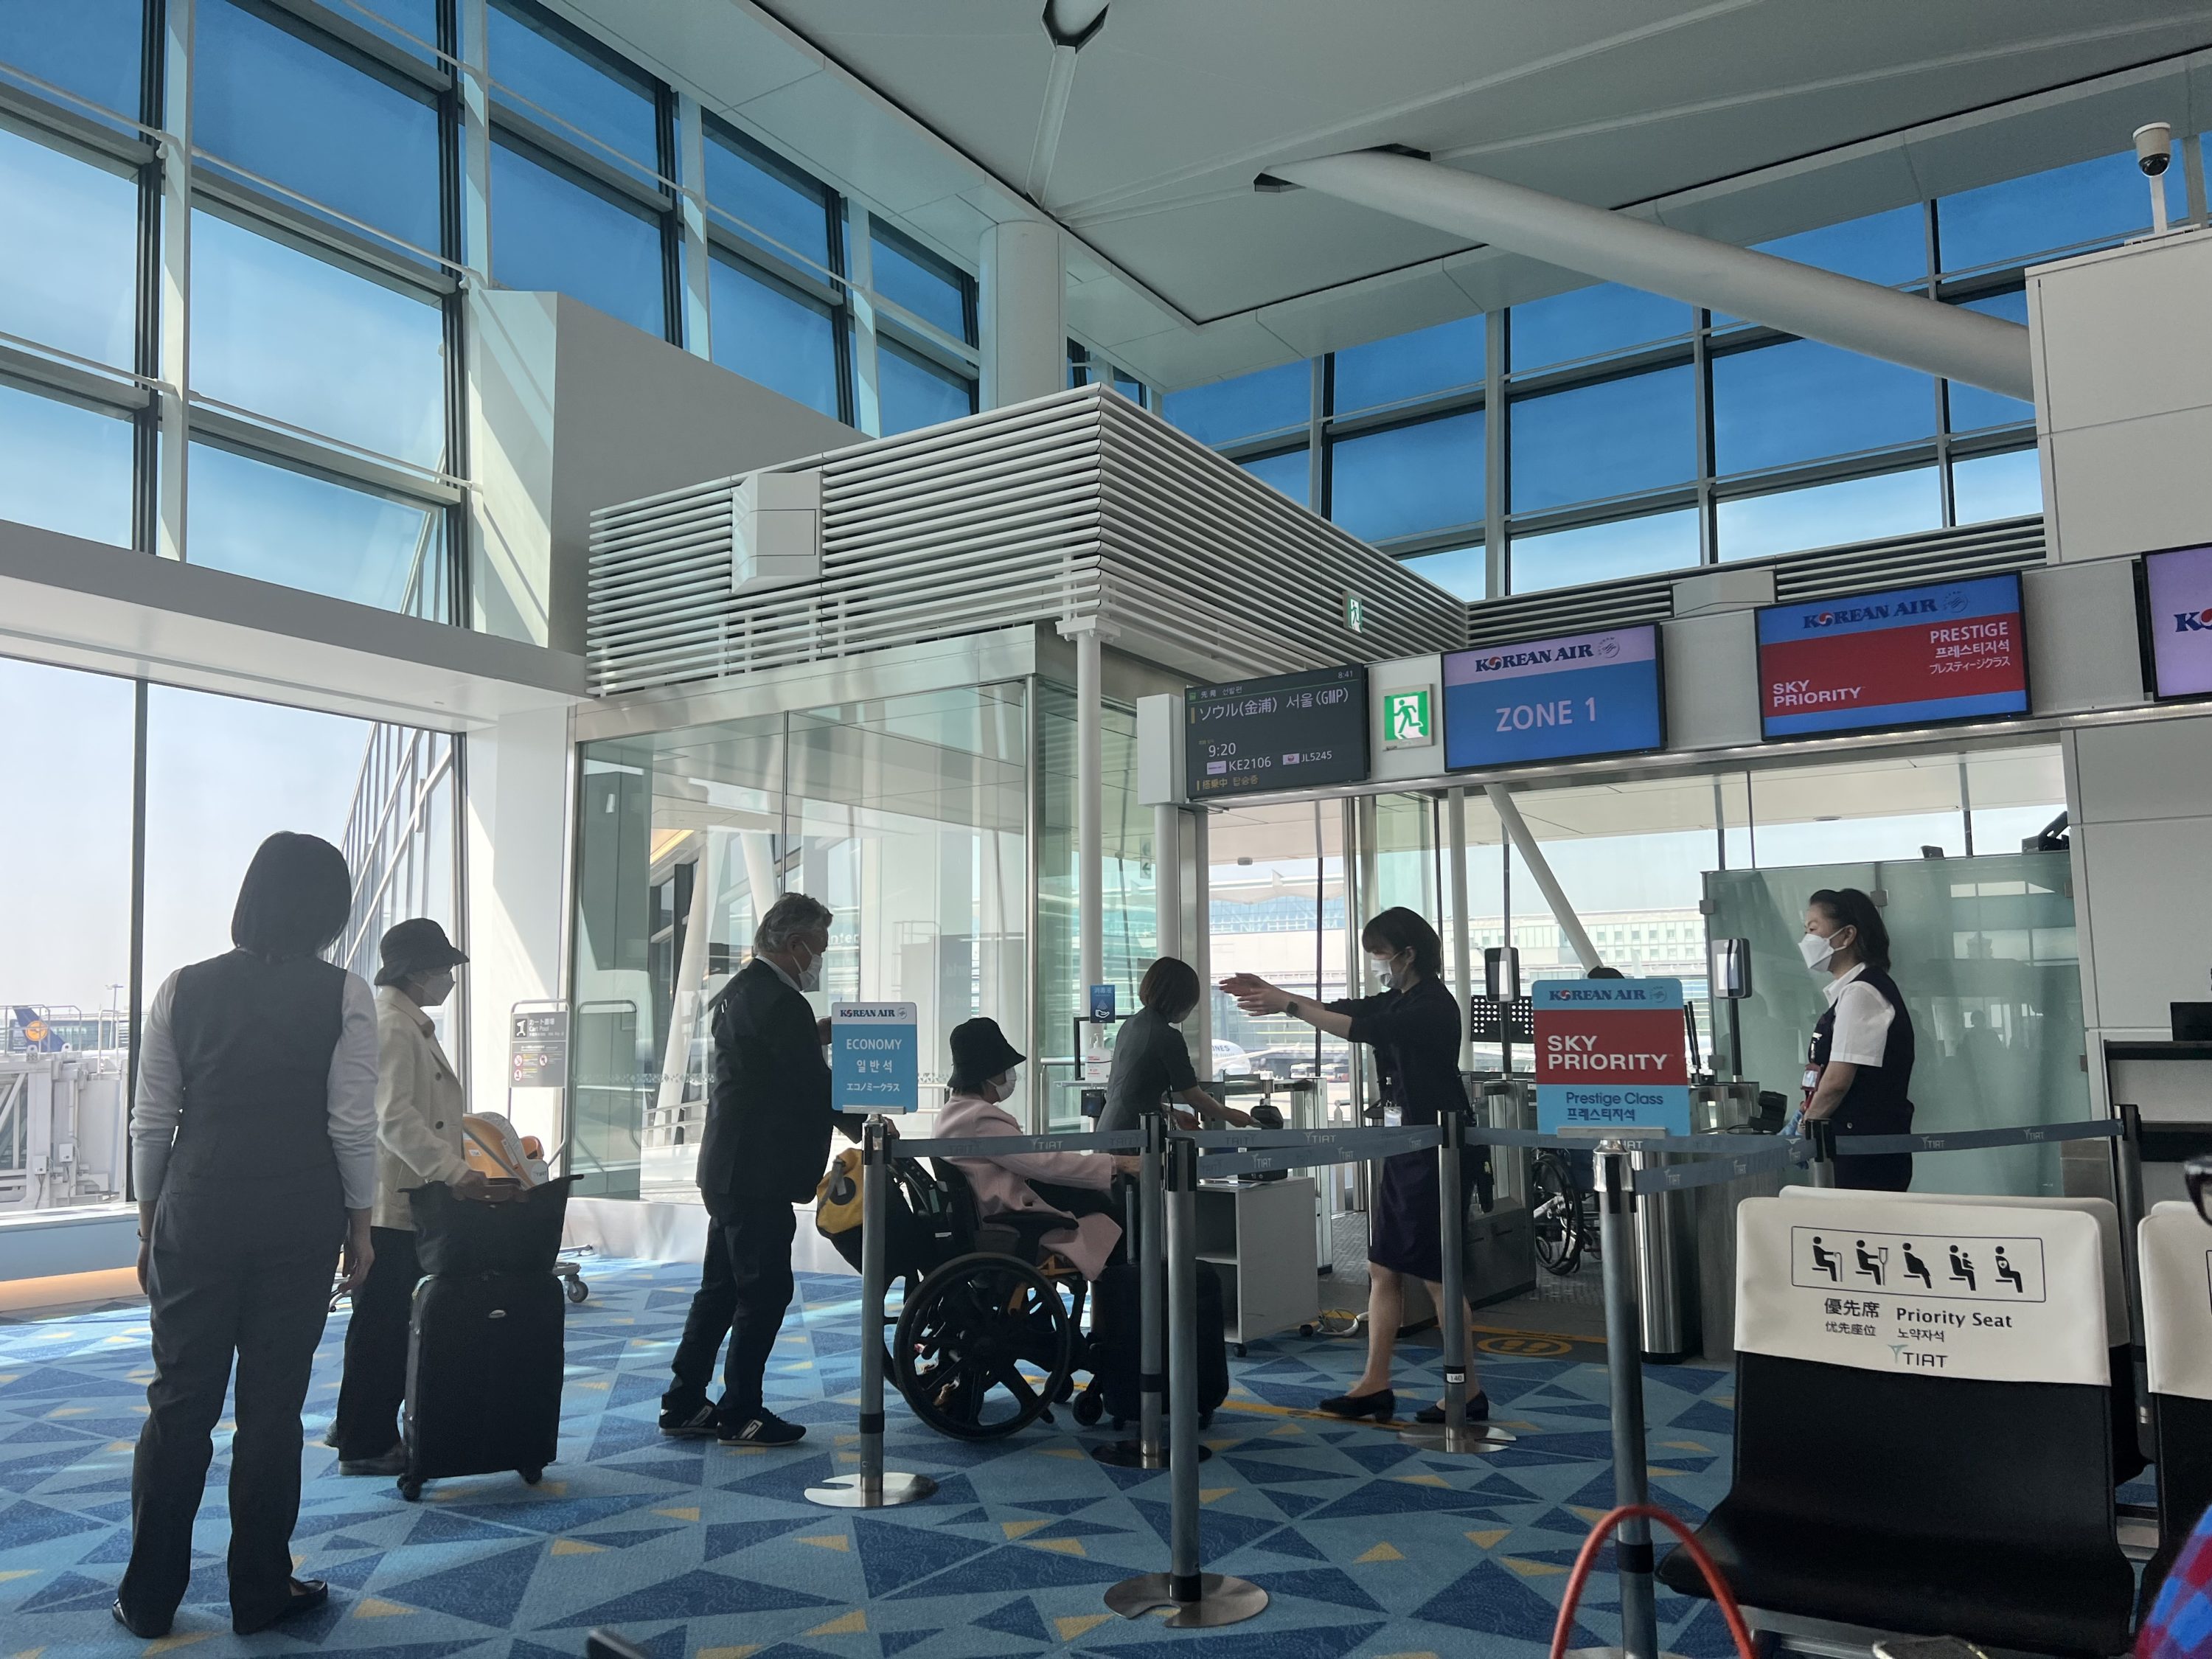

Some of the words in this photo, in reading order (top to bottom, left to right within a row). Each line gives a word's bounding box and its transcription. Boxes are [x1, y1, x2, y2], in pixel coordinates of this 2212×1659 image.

[1804, 605, 1889, 629] KOREAN
[1893, 598, 1938, 617] AIR
[1930, 622, 2008, 644] PRESTIGE
[1935, 639, 2010, 658] 프레스티지석
[1475, 650, 1551, 672] KOREAN
[1555, 644, 1594, 661] AIR
[1930, 655, 2010, 675] プレスティージクラス
[1338, 670, 1353, 679] 8:41
[1773, 680, 1810, 695] SKY
[1773, 686, 1862, 707] PRIORITY
[1200, 697, 1278, 721] ソウル(金浦)
[1496, 700, 1573, 731] ZONE
[1585, 697, 1596, 721] 1
[1208, 742, 1236, 757] 9:20
[1301, 751, 1332, 762] JL5245
[1229, 757, 1271, 771] KE2106
[1549, 990, 1612, 1001] KOREAN
[1615, 990, 1646, 1001] AIR
[840, 1009, 876, 1018] KOREAN
[877, 1009, 895, 1018] AIR
[846, 1038, 902, 1050] ECONOMY
[1548, 1035, 1598, 1051] SKY
[1548, 1054, 1668, 1070] PRIORITY
[846, 1082, 900, 1092] エコノミークラス
[1566, 1092, 1621, 1106] Prestige
[1624, 1092, 1663, 1105] Class
[1568, 1108, 1635, 1121] 프레스티지석
[1623, 1141, 1643, 1149] IAT
[1824, 1298, 1880, 1318] 優先席
[1897, 1307, 1966, 1328] Priority
[1972, 1313, 2012, 1329] Seat
[1825, 1321, 1877, 1338] 优先座位
[1897, 1327, 1945, 1343] 노약자석
[1903, 1352, 1949, 1368] TIAT
